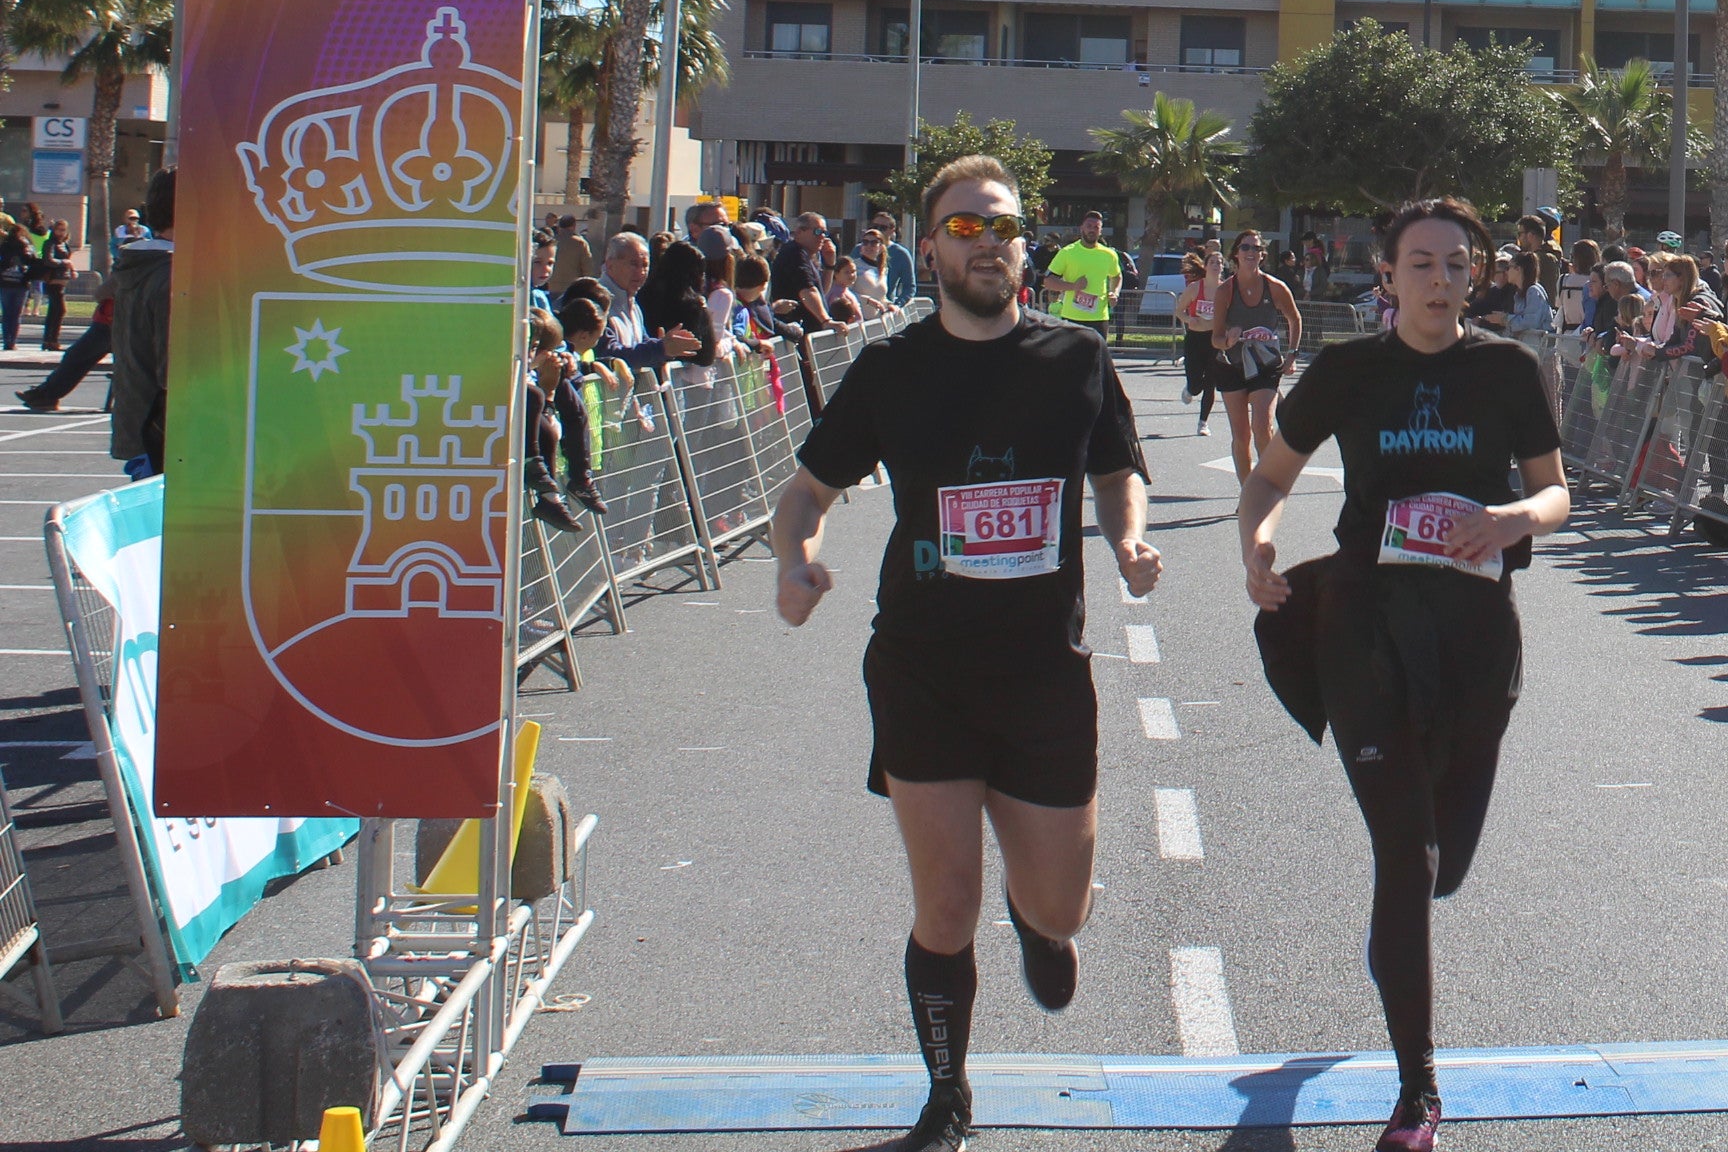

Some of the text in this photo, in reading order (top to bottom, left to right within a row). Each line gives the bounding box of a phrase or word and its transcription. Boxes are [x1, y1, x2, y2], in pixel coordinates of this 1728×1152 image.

[44, 118, 74, 137] CS
[1380, 429, 1474, 450] DAYRON
[974, 488, 1008, 499] CARRERA
[1010, 485, 1042, 496] POPULAR
[961, 496, 1039, 510] CIUDAD DE ROQUETAS
[974, 508, 1033, 540] 681
[960, 551, 1045, 568] meetingpoint
[917, 991, 954, 1080] kalenji
